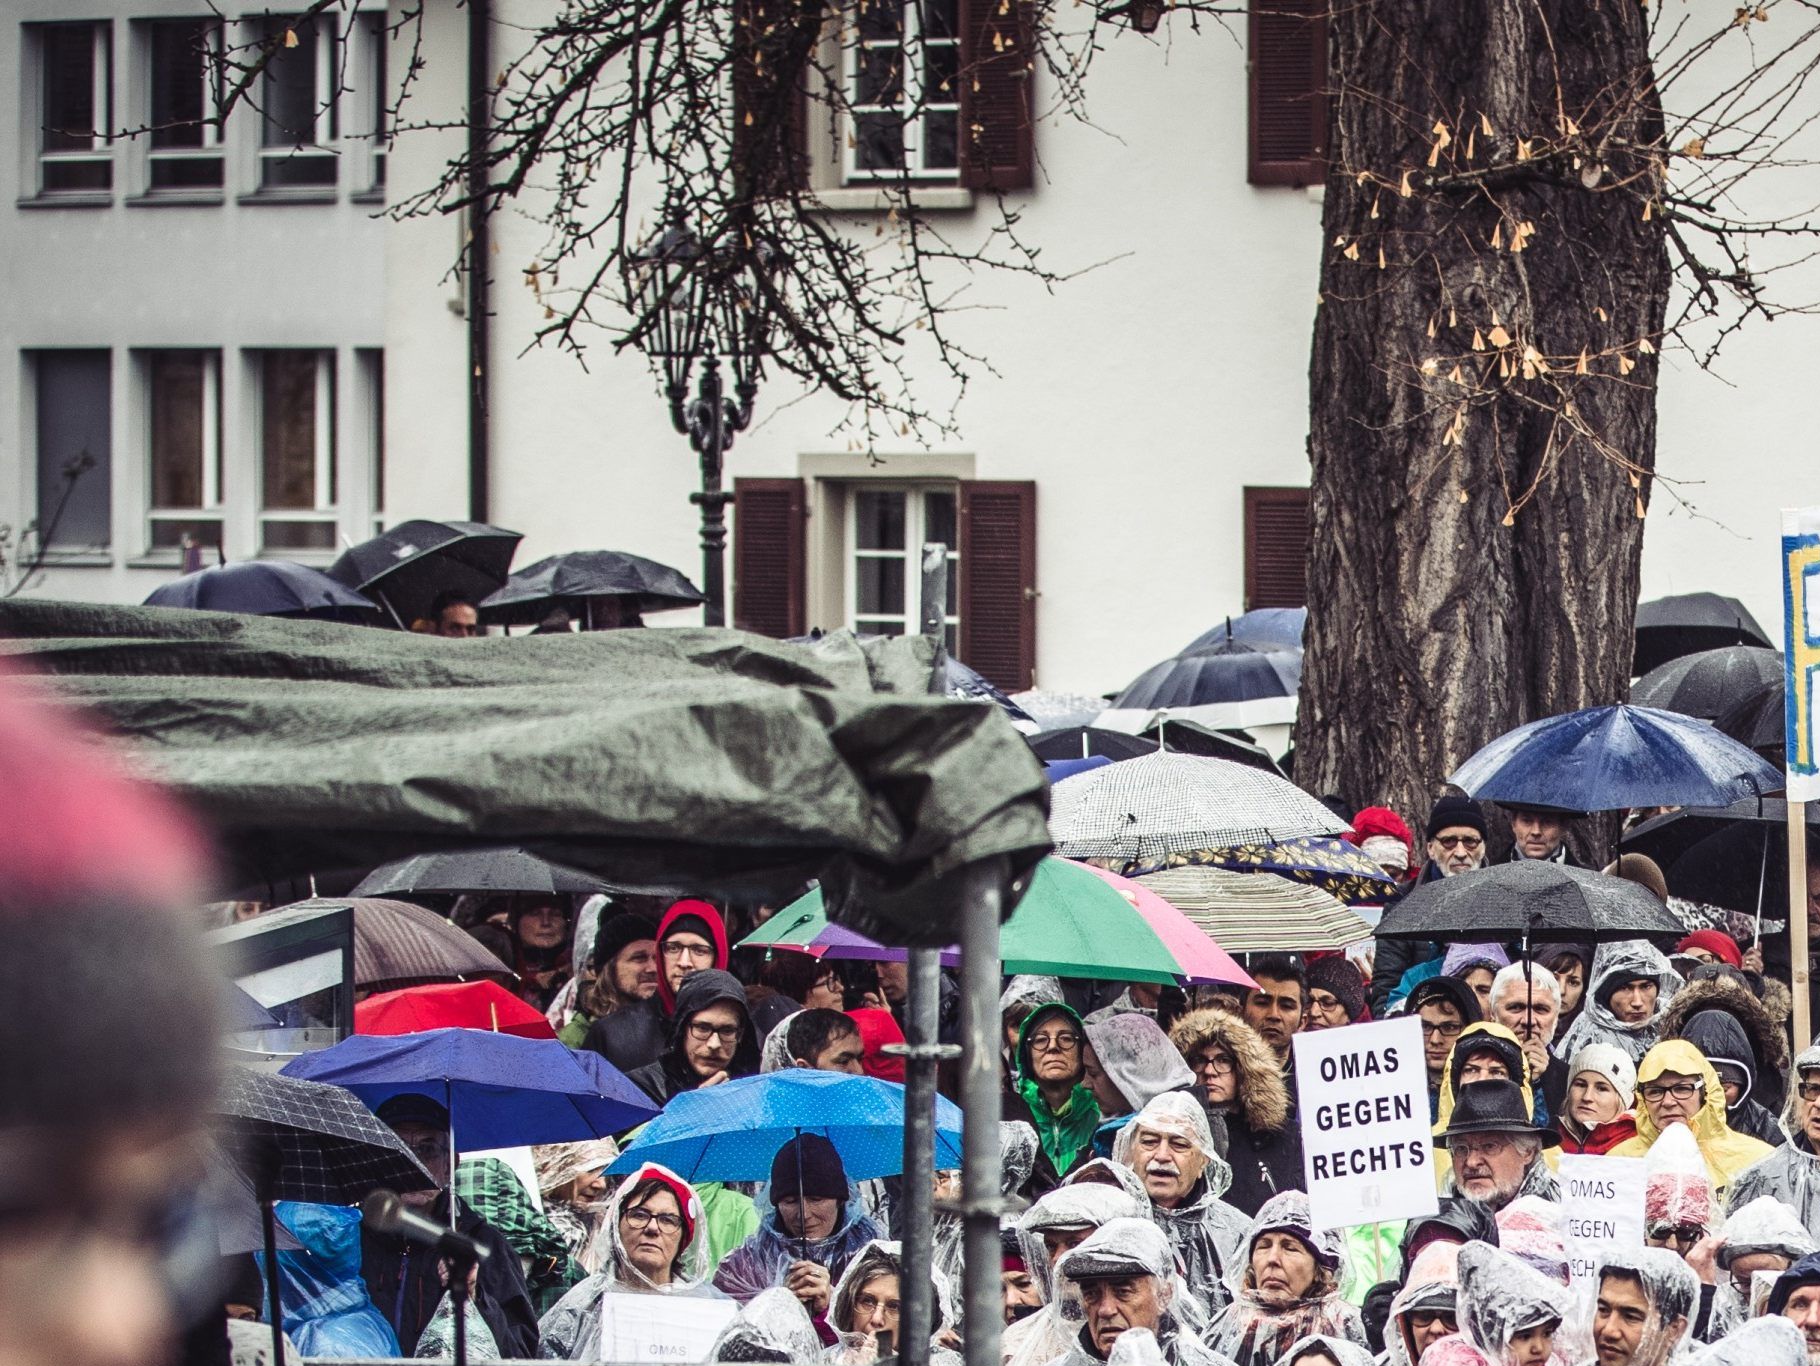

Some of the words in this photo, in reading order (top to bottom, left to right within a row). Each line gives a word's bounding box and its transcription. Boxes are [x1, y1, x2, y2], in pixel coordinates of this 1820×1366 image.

[1320, 1047, 1399, 1082] OMAS
[1316, 1094, 1412, 1131] GEGEN
[1312, 1141, 1425, 1181] RECHTS
[1570, 1179, 1615, 1200] OMAS
[648, 1343, 688, 1356] OMAS
